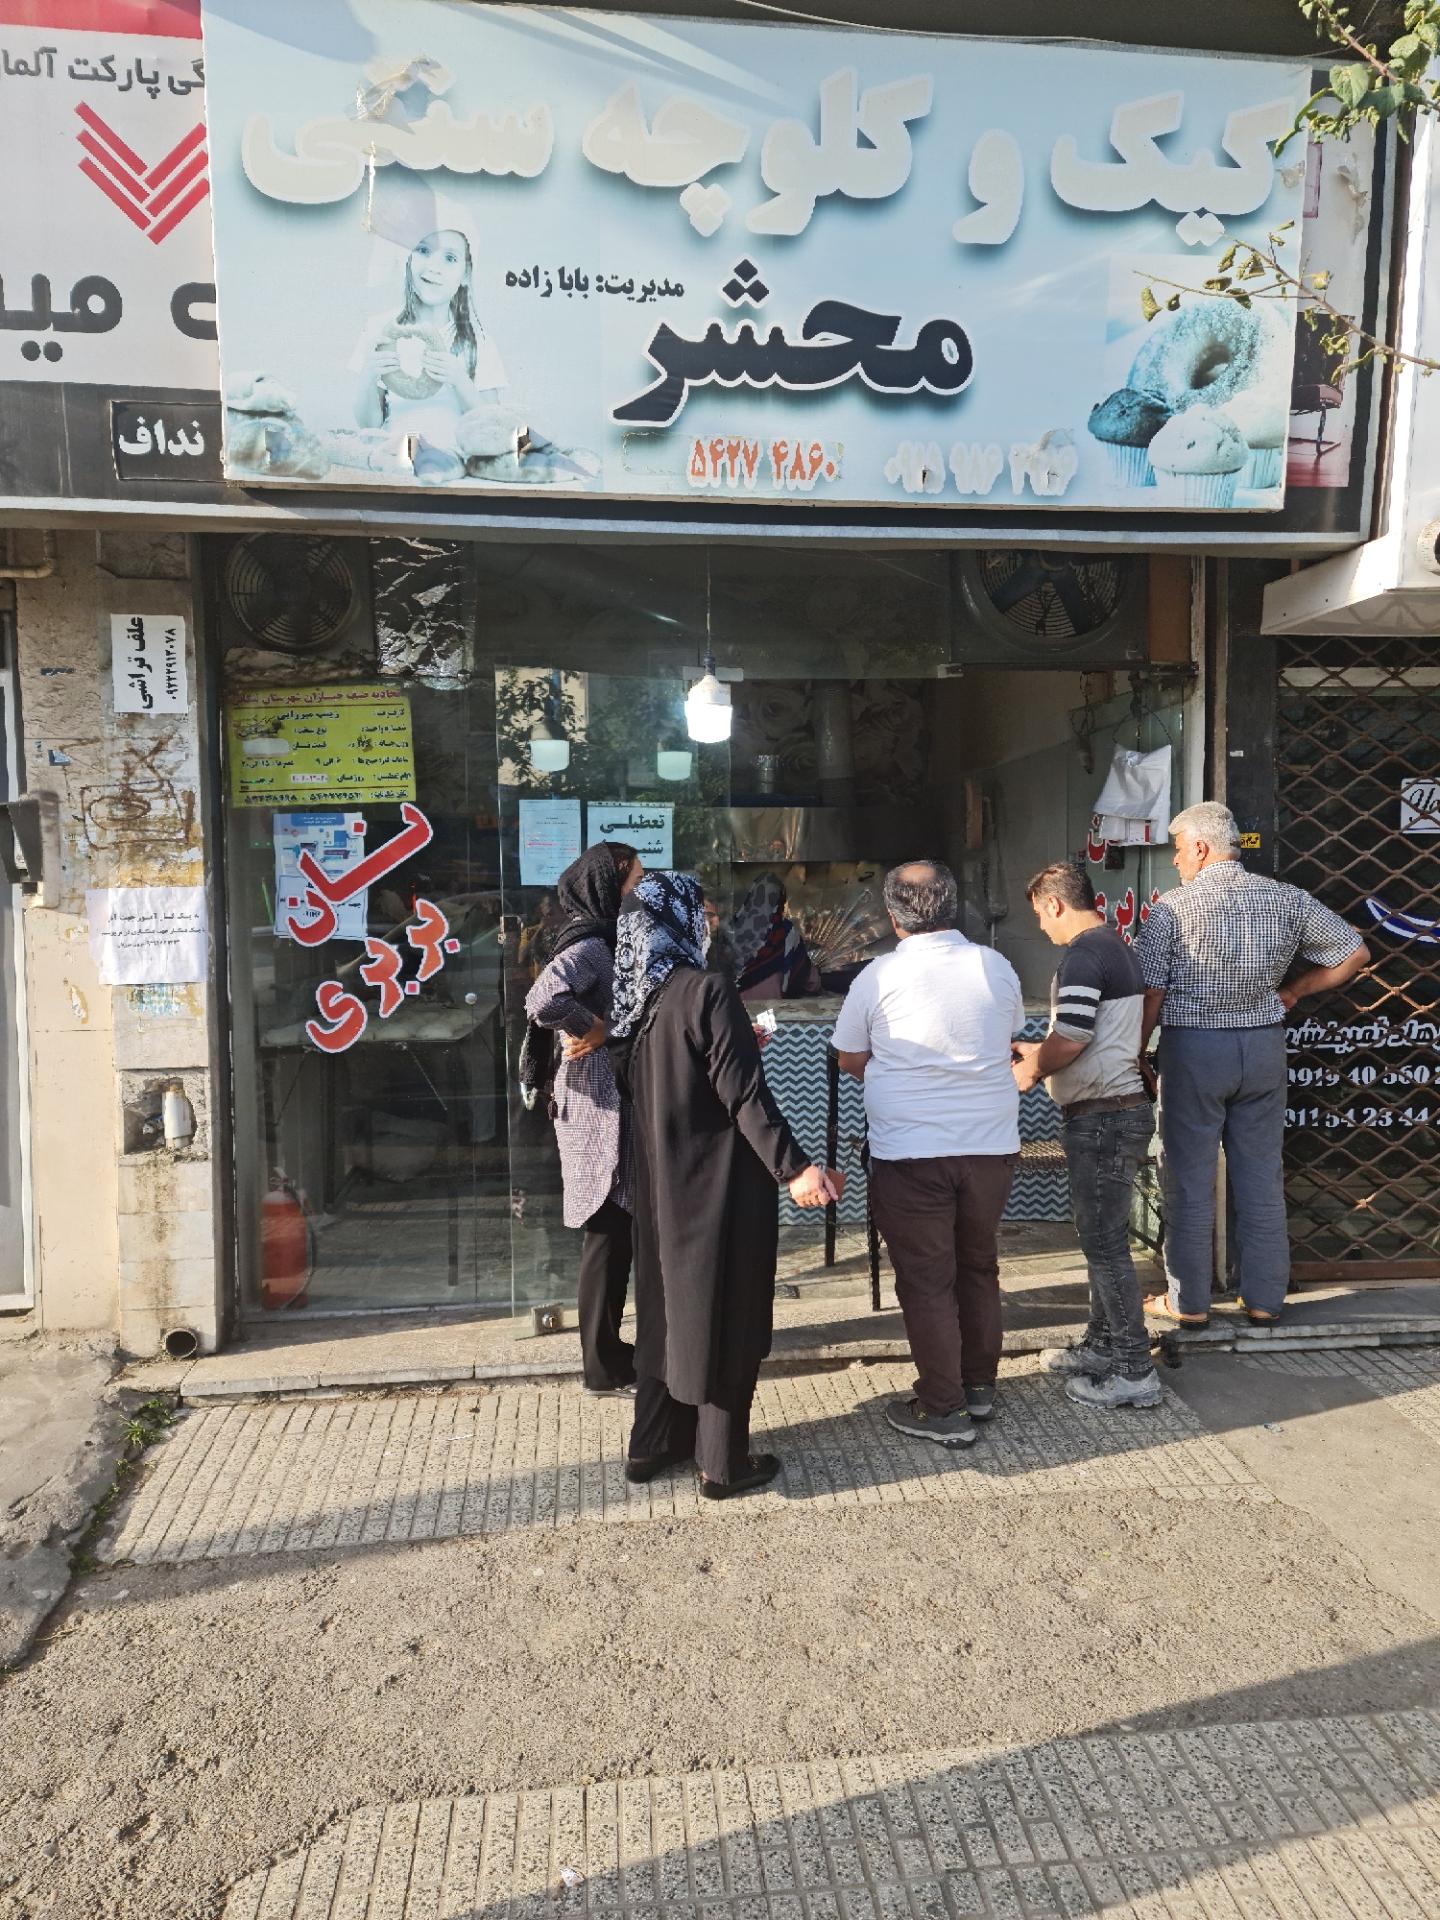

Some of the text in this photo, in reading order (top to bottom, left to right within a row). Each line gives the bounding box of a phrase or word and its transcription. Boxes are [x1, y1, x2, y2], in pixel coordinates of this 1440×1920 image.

[68, 54, 160, 100] پارکت
[581, 66, 933, 238] کلوچه
[952, 128, 1024, 245] و
[1050, 91, 1297, 246] کیک
[608, 255, 975, 426] محشر
[119, 416, 205, 456] نداف
[126, 616, 146, 652] علف
[286, 802, 434, 947] نان
[600, 813, 665, 834] تعطیلی
